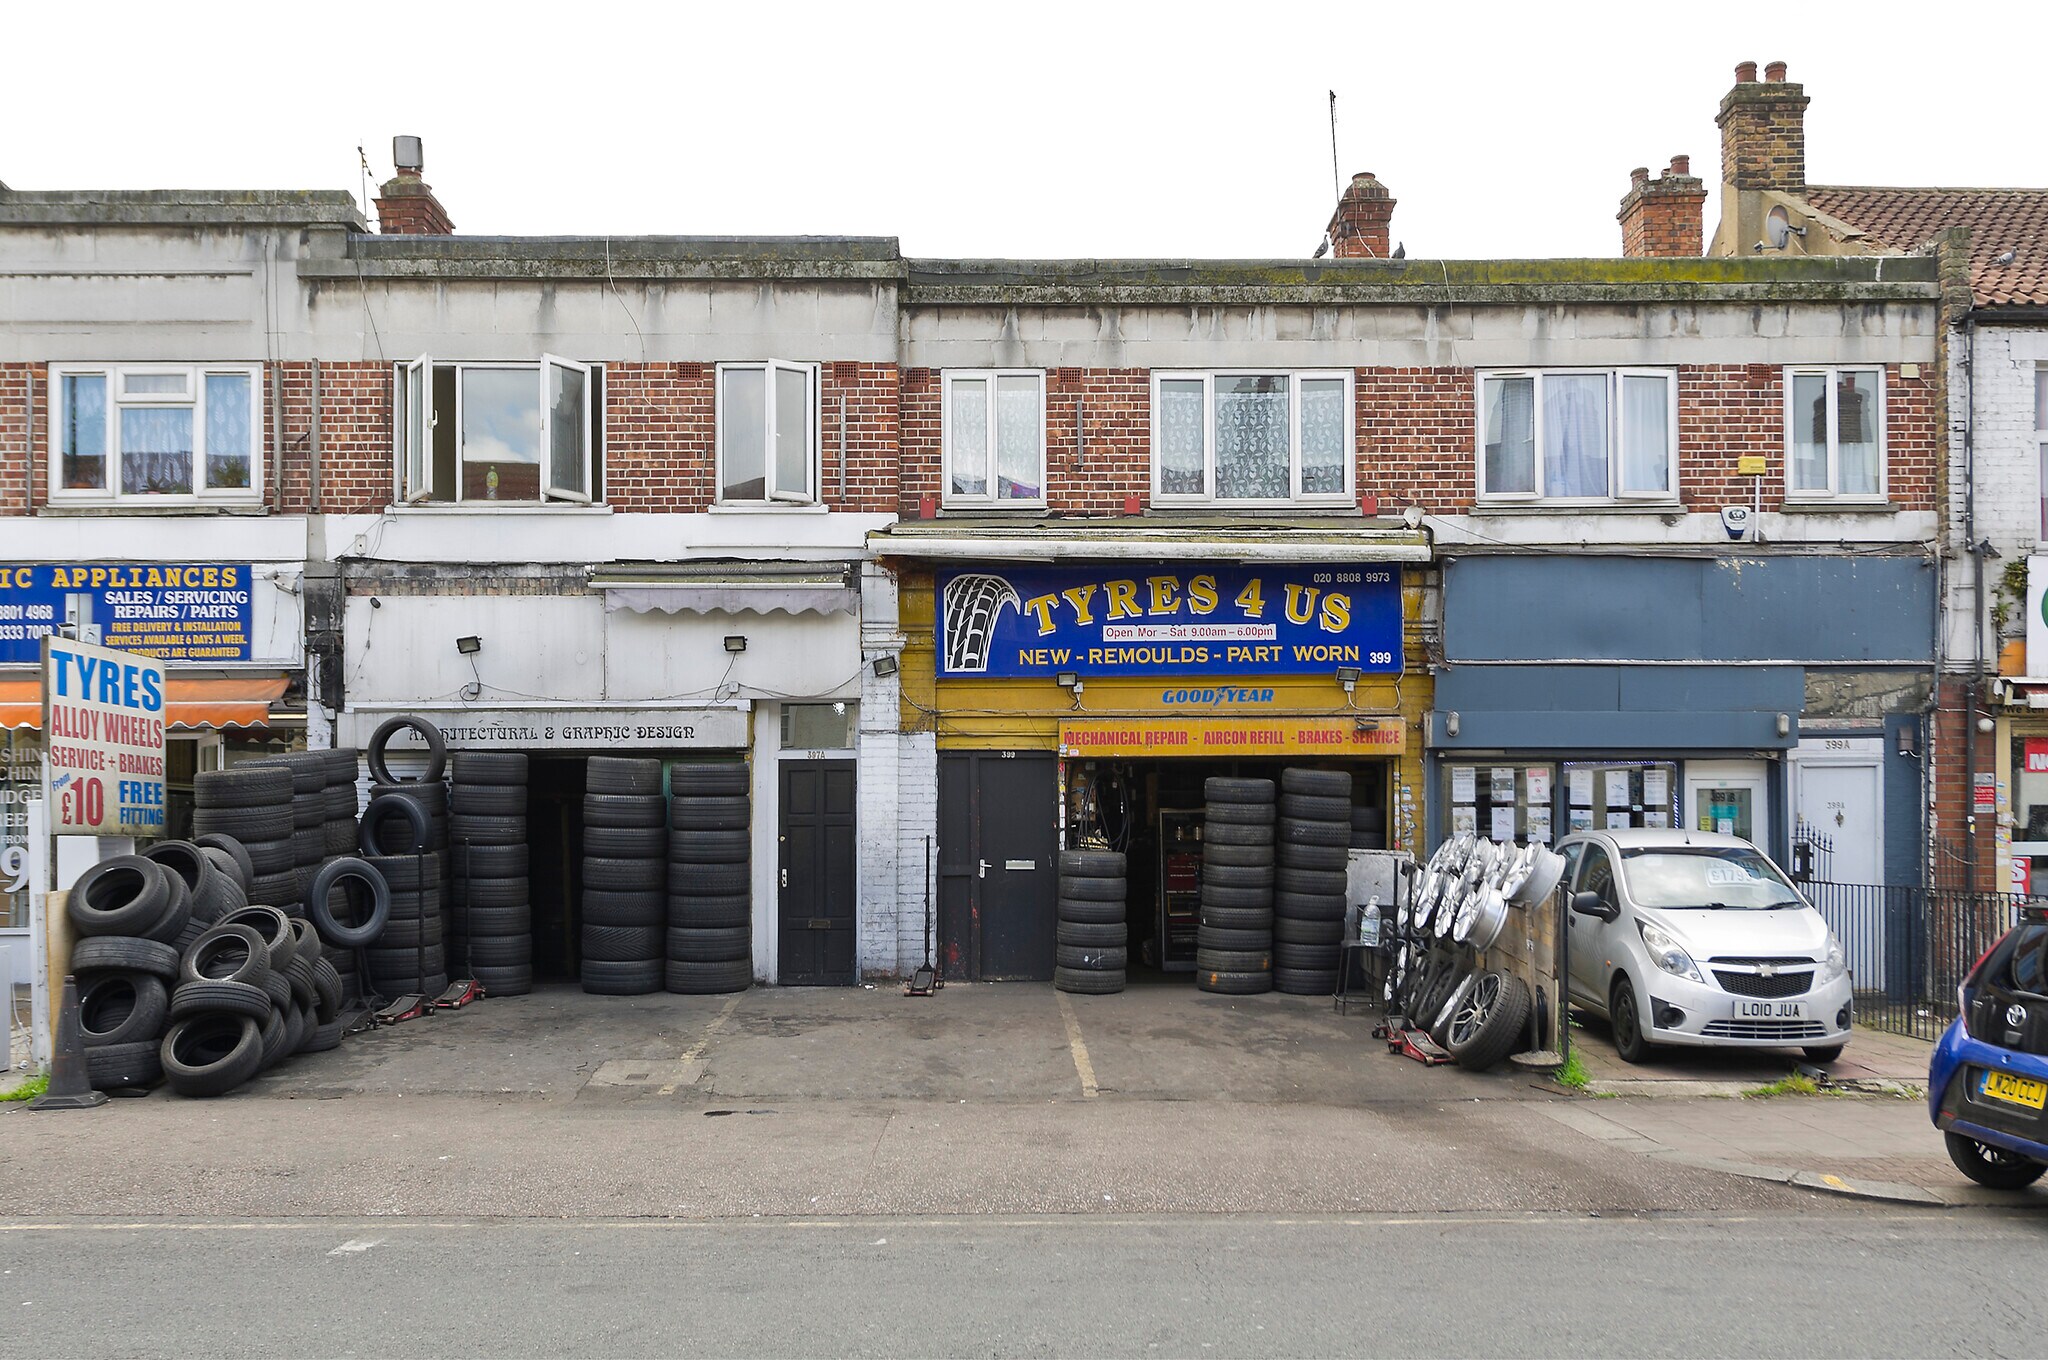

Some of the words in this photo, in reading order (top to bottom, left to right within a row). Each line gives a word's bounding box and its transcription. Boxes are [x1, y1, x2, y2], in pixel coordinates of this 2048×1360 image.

[52, 568, 237, 588] APPLIANCES
[1313, 573, 1332, 583] 020
[1336, 573, 1361, 583] 8808
[1366, 572, 1390, 582] 9973
[105, 591, 153, 605] SALES
[164, 590, 248, 605] SERVICING
[25, 604, 53, 620] 4968
[114, 605, 179, 619] REPAIRS
[190, 605, 239, 618] PARTS
[1024, 575, 1219, 636] TYRES
[1235, 578, 1266, 618] 4
[1284, 583, 1351, 633] US
[112, 622, 131, 632] FREE
[133, 622, 171, 632] DELIVERY
[174, 622, 181, 632] &
[183, 621, 241, 631] INSTALLATION
[1106, 627, 1133, 639] Open
[1170, 627, 1187, 637] Sat
[1191, 627, 1227, 637] 9.00am
[1237, 626, 1273, 638] 6.00pm
[105, 635, 142, 646] SERVICES
[143, 635, 184, 645] AVAILABLE
[185, 634, 192, 645] 6
[193, 634, 214, 644] DAYS
[214, 634, 221, 644] A
[222, 634, 247, 644] WEEK.
[171, 648, 187, 657] ARE
[188, 647, 241, 657] GUARANTEED
[1019, 649, 1071, 665] NEW
[1089, 647, 1209, 665] REMOULDS
[1227, 646, 1283, 662] PART
[1293, 646, 1359, 662] WORN
[1369, 651, 1392, 664] 399
[50, 648, 162, 712] TYRES
[1162, 686, 1274, 705] GOODYEAR
[51, 704, 101, 741] ALLOY
[103, 711, 163, 749] WHEELS
[409, 726, 538, 743] AHITECTURAL
[544, 726, 555, 740] &
[562, 726, 630, 742] GRAPHIC
[636, 726, 695, 739] DESIGN
[1063, 731, 1142, 745] MECHANICAL
[1145, 731, 1188, 745] REPAIR
[1203, 731, 1247, 745] AIRCON
[1250, 731, 1284, 744] REFILL
[1298, 730, 1342, 744] BRAKES
[1352, 730, 1400, 744] SERVICE
[51, 745, 105, 771] SERVICE
[119, 753, 163, 776] BRAKES
[807, 750, 826, 759] 397A
[1001, 750, 1016, 759] 399
[0, 766, 43, 781] CHIN
[119, 780, 163, 805] FREE
[61, 776, 104, 827] £10
[119, 807, 164, 825] FITTING
[1775, 1003, 1800, 1017] JUA
